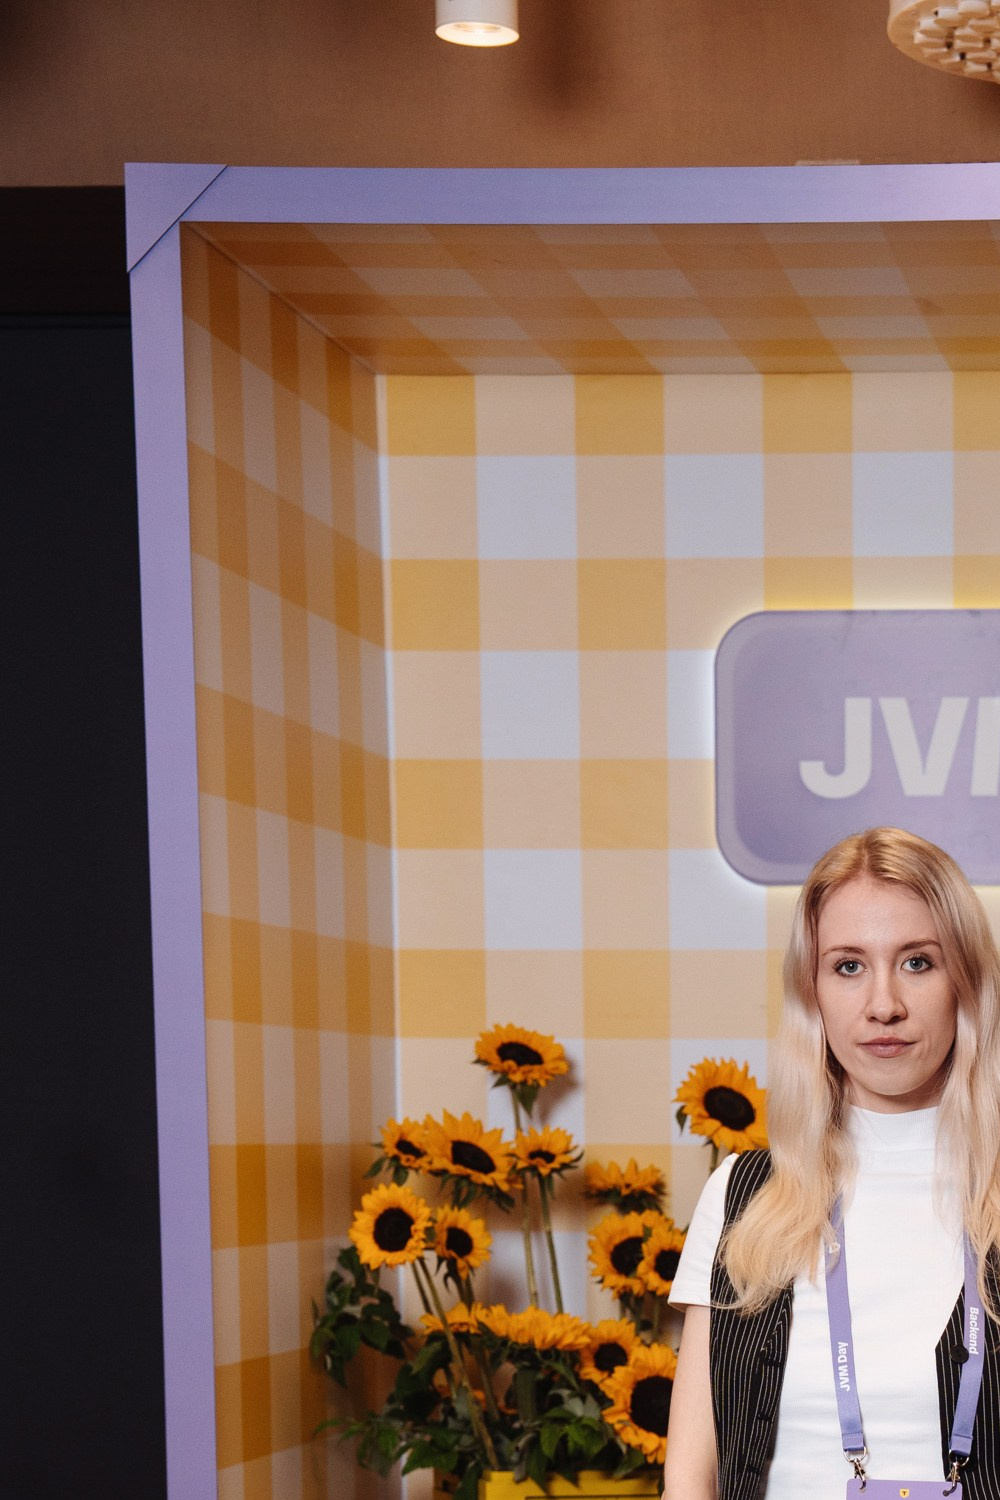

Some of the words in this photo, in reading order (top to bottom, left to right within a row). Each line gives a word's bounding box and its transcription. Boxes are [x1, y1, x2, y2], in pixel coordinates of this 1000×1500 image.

[969, 1306, 979, 1355] Backend
[837, 1341, 849, 1364] Day
[838, 1364, 850, 1392] JVM
